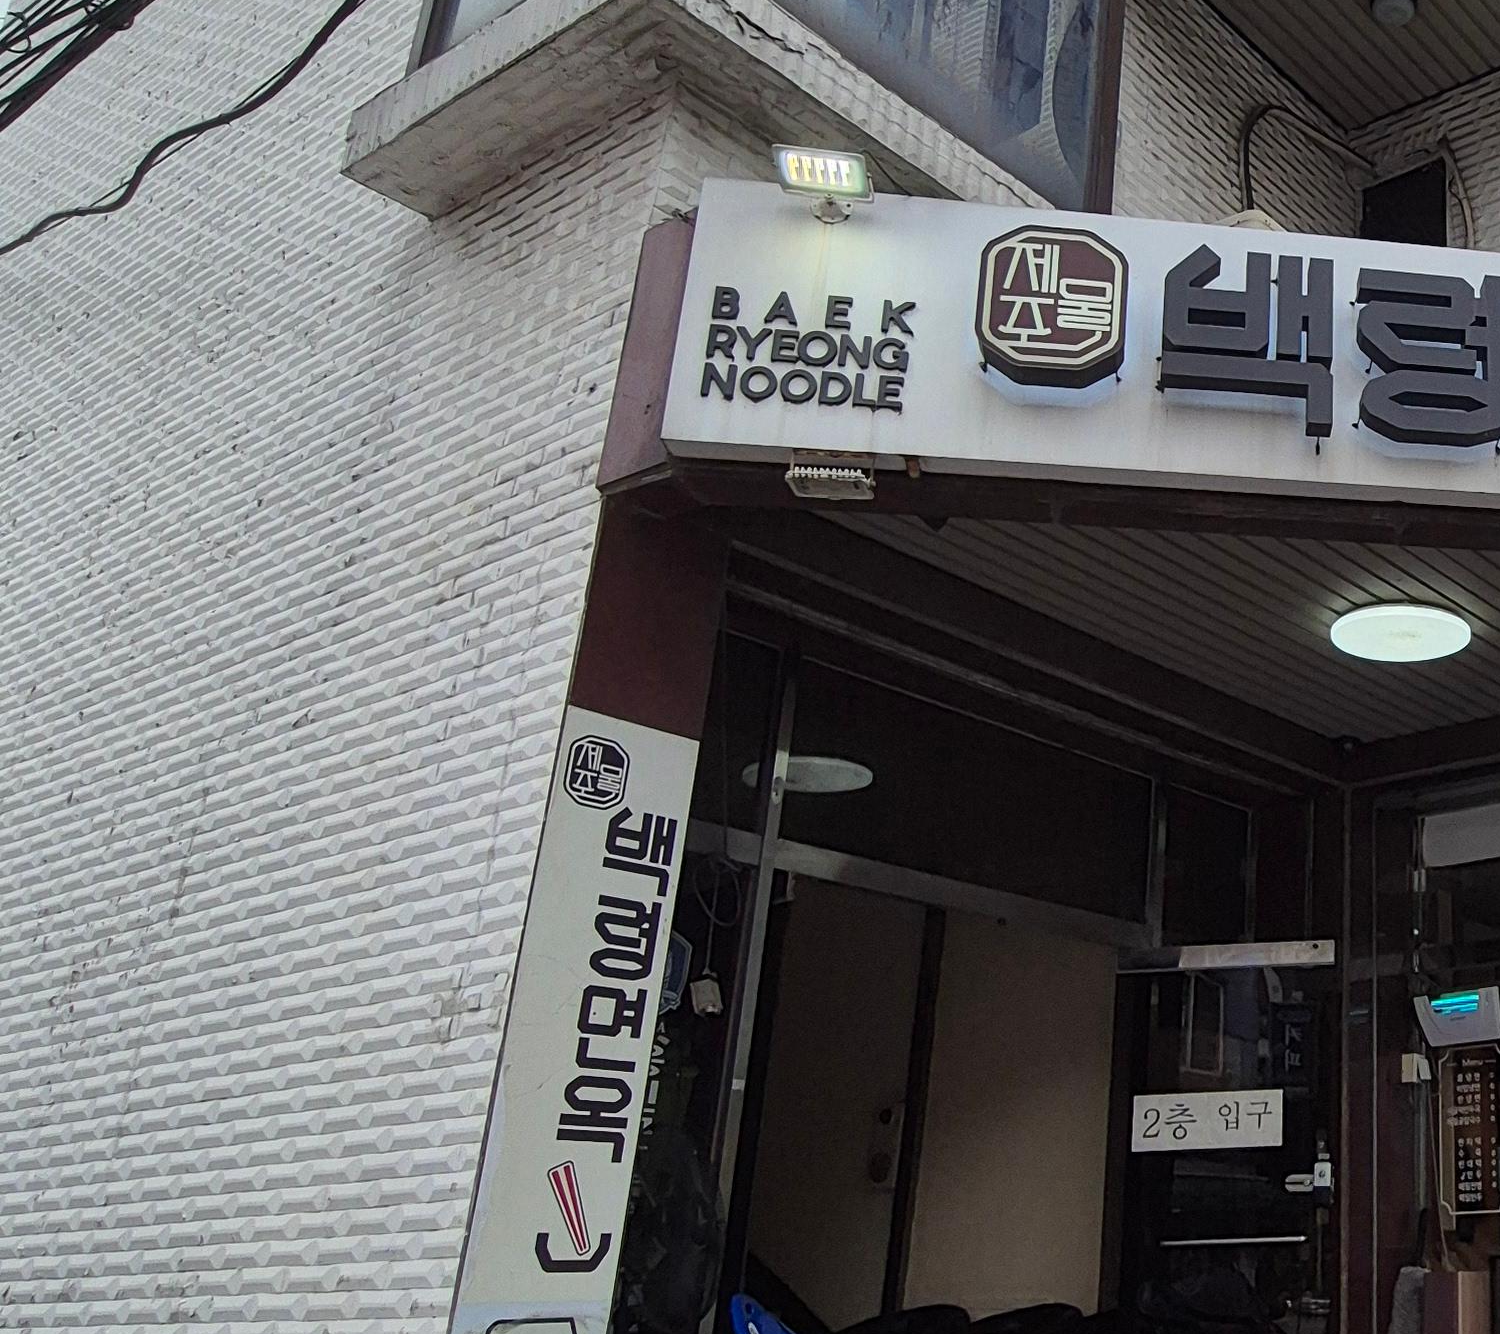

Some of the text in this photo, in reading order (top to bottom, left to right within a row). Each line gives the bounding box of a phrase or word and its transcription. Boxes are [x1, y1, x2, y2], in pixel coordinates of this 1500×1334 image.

[712, 284, 916, 334] BAEK
[999, 241, 1114, 351] 제물포
[705, 323, 910, 373] RYEONG
[700, 361, 904, 412] NOODLE
[556, 806, 678, 1164] 백령면옥
[1142, 1098, 1275, 1141] 2층 입구
